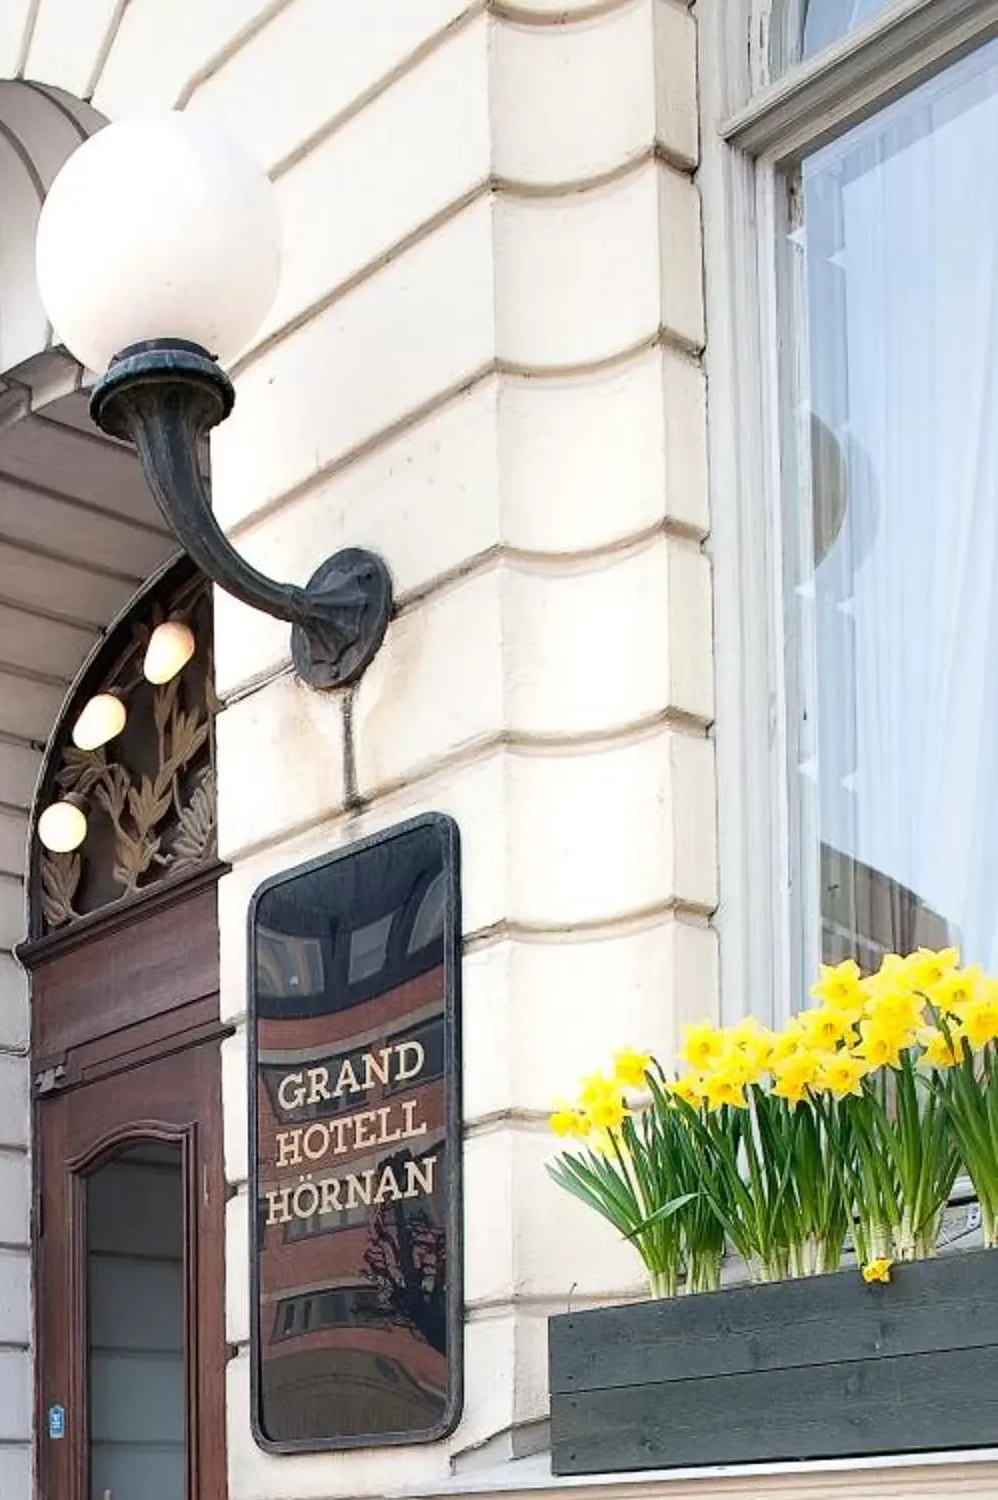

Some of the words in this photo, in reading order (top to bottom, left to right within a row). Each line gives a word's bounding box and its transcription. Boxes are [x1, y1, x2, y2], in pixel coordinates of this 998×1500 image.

[277, 1041, 425, 1110] GRAND
[275, 1100, 427, 1167] HOTELL
[265, 1156, 437, 1225] HÖRNAN
